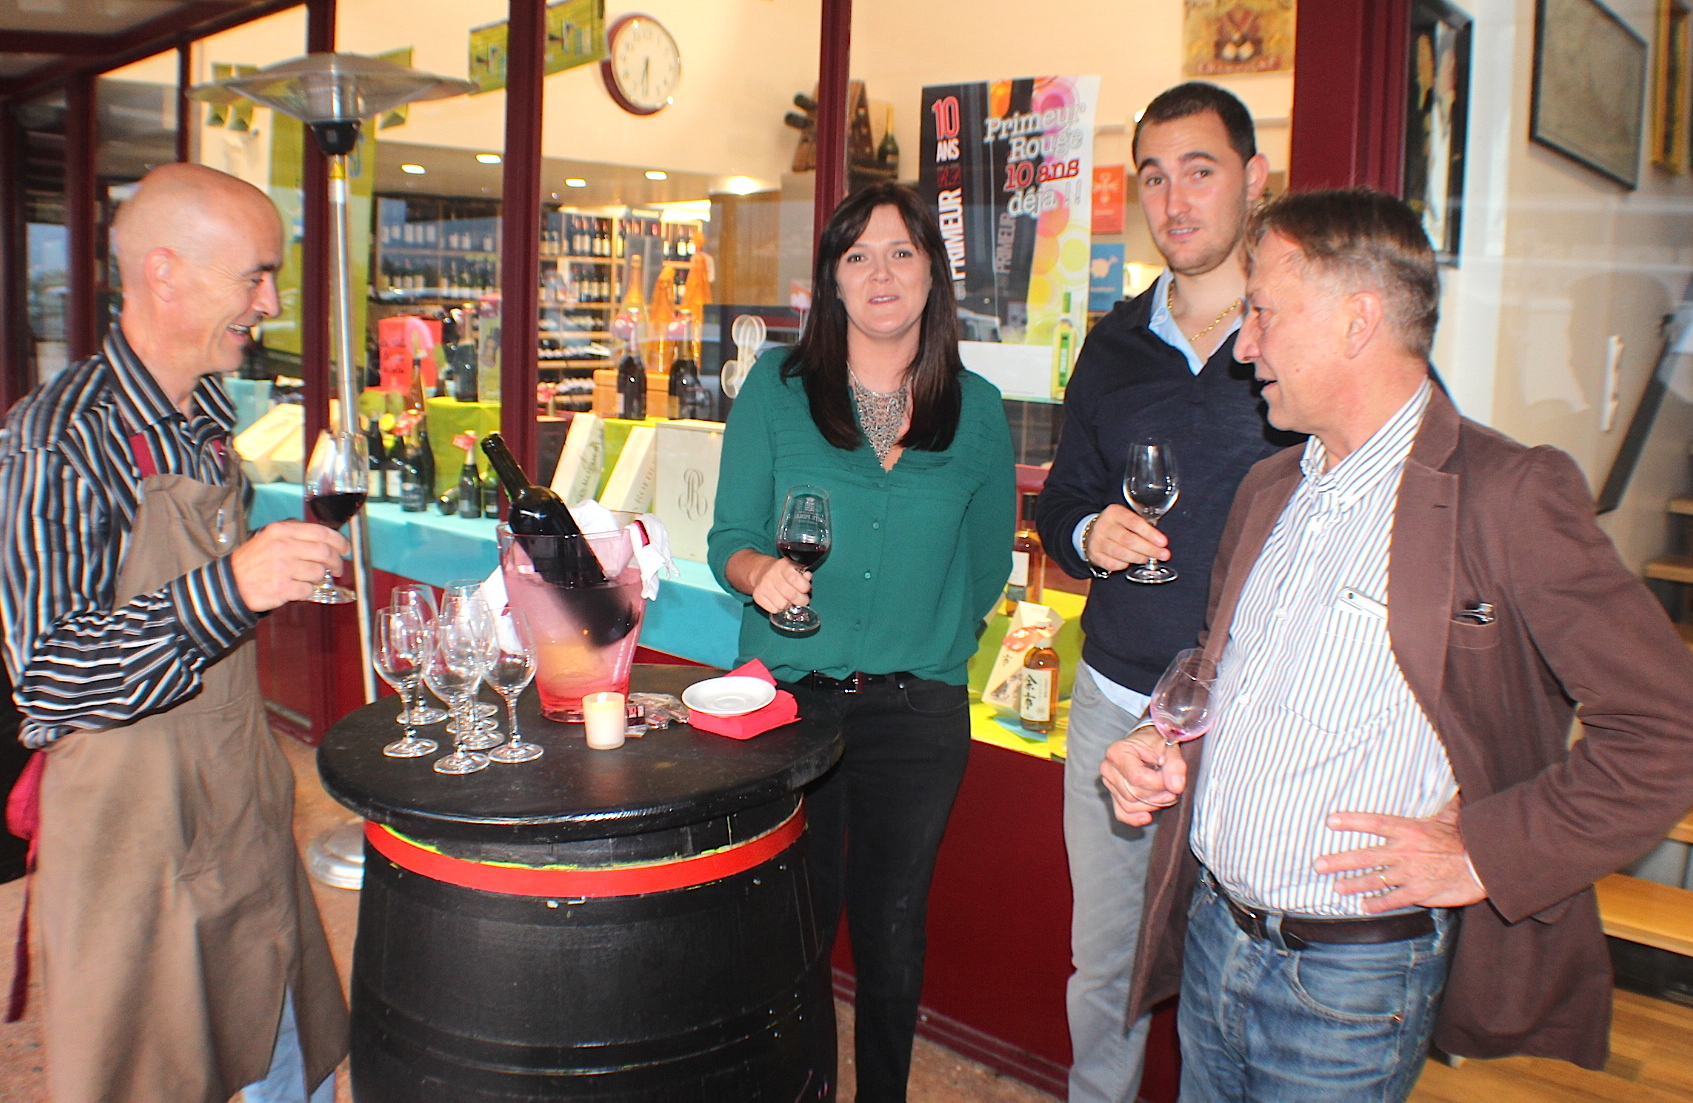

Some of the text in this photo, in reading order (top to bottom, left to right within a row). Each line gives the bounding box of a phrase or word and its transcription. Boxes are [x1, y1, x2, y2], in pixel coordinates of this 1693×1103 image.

[931, 95, 961, 139] 10
[982, 102, 1087, 144] Primeur
[936, 138, 961, 163] ANS
[1007, 125, 1084, 164] Rouge
[1003, 158, 1081, 193] 10 ans
